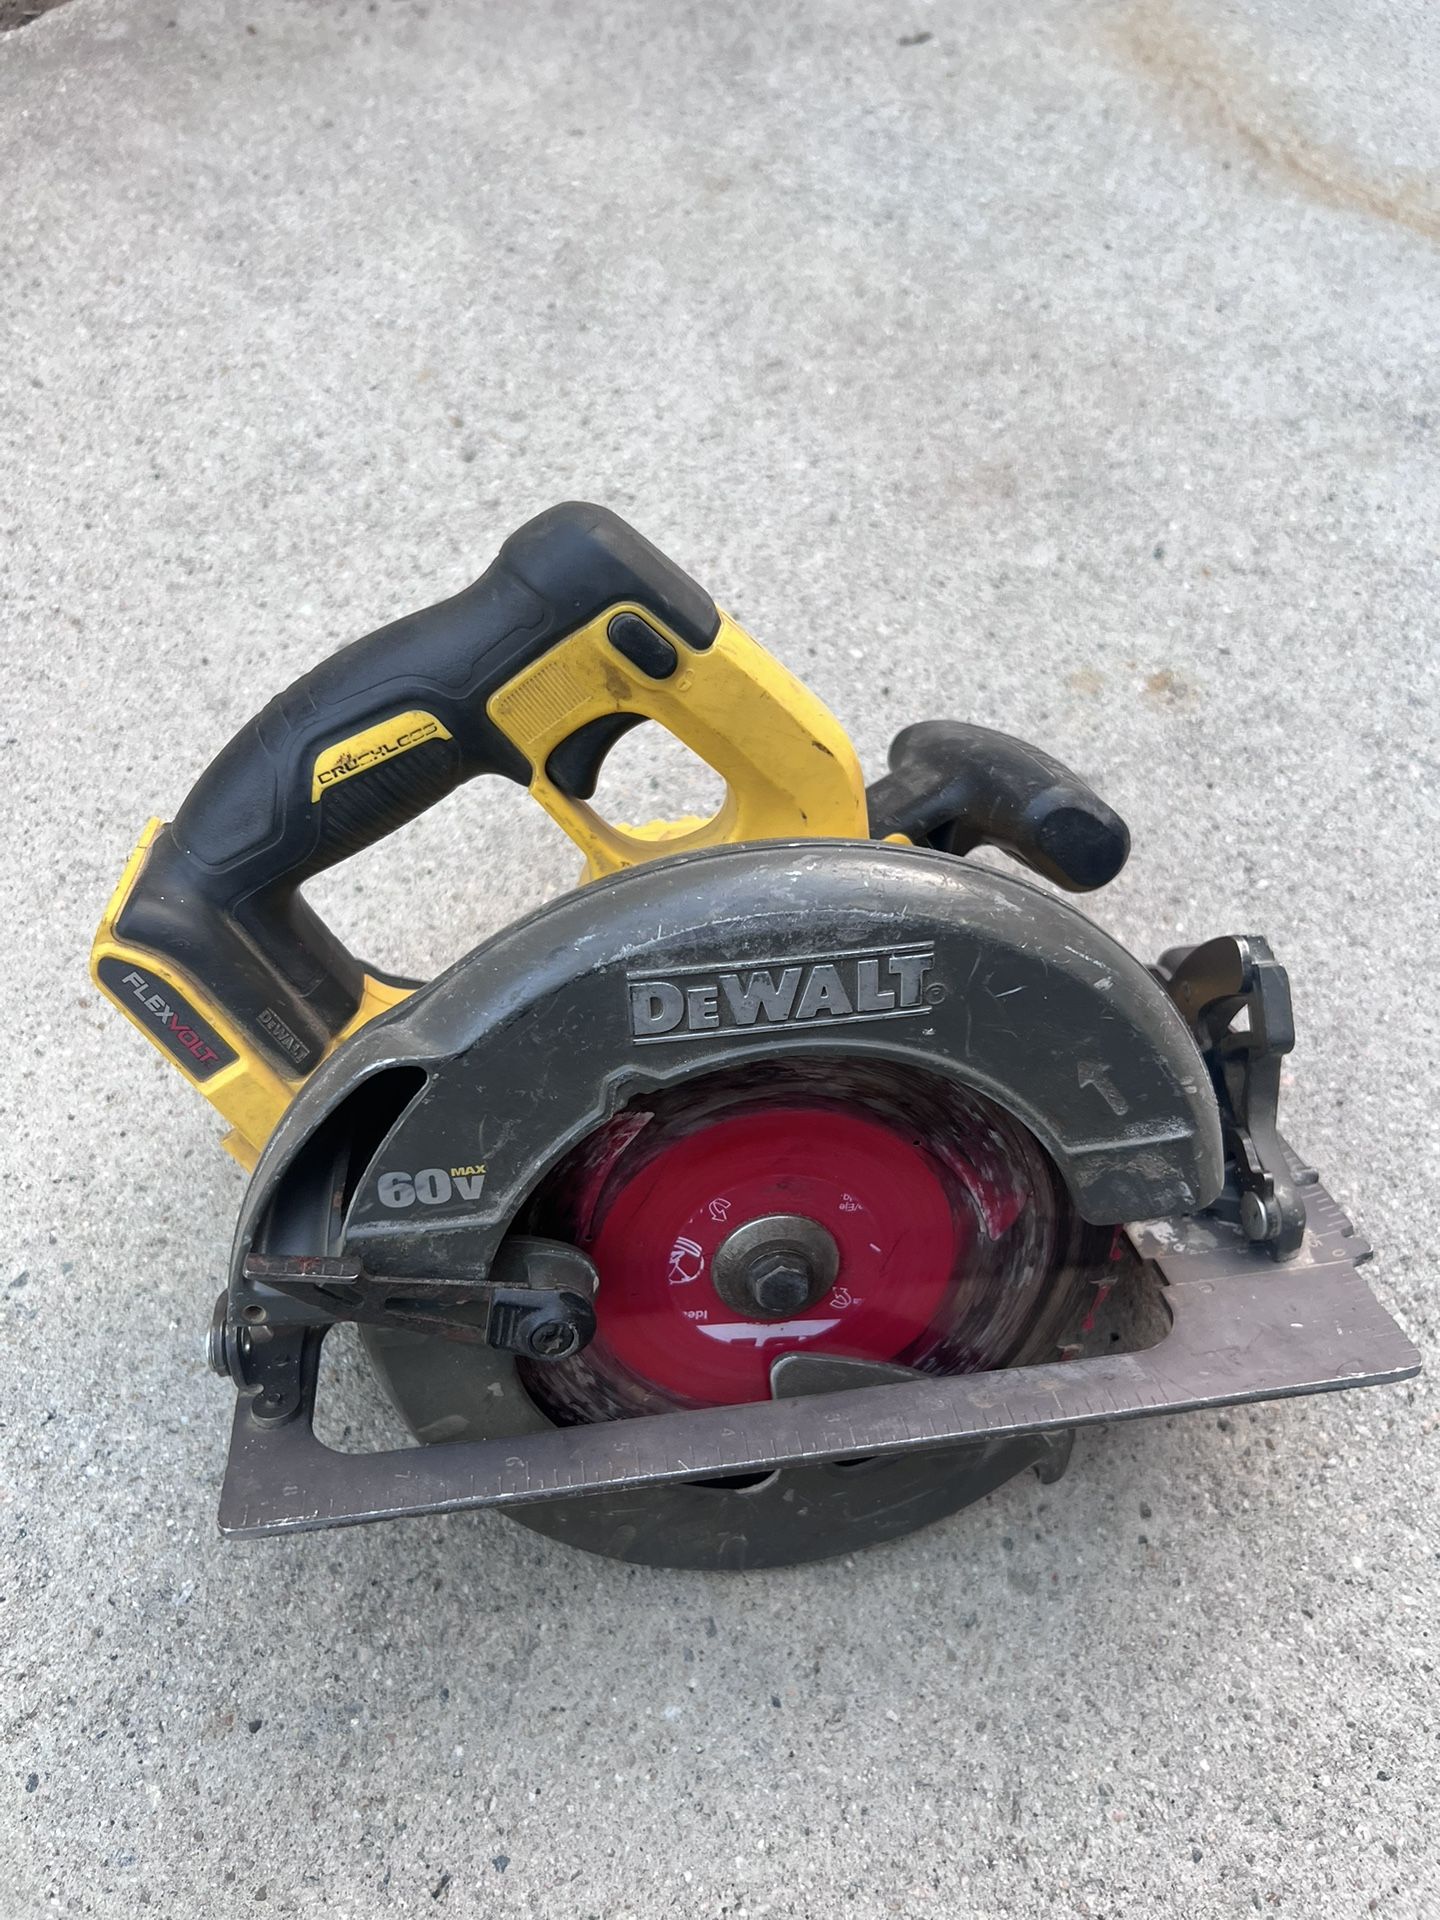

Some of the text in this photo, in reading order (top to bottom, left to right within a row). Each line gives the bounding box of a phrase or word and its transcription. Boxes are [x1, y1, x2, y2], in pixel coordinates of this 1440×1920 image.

[121, 971, 219, 1061] FLEXVOLT
[629, 952, 935, 1036] DEWALT
[378, 1164, 487, 1208] 60V MAX
